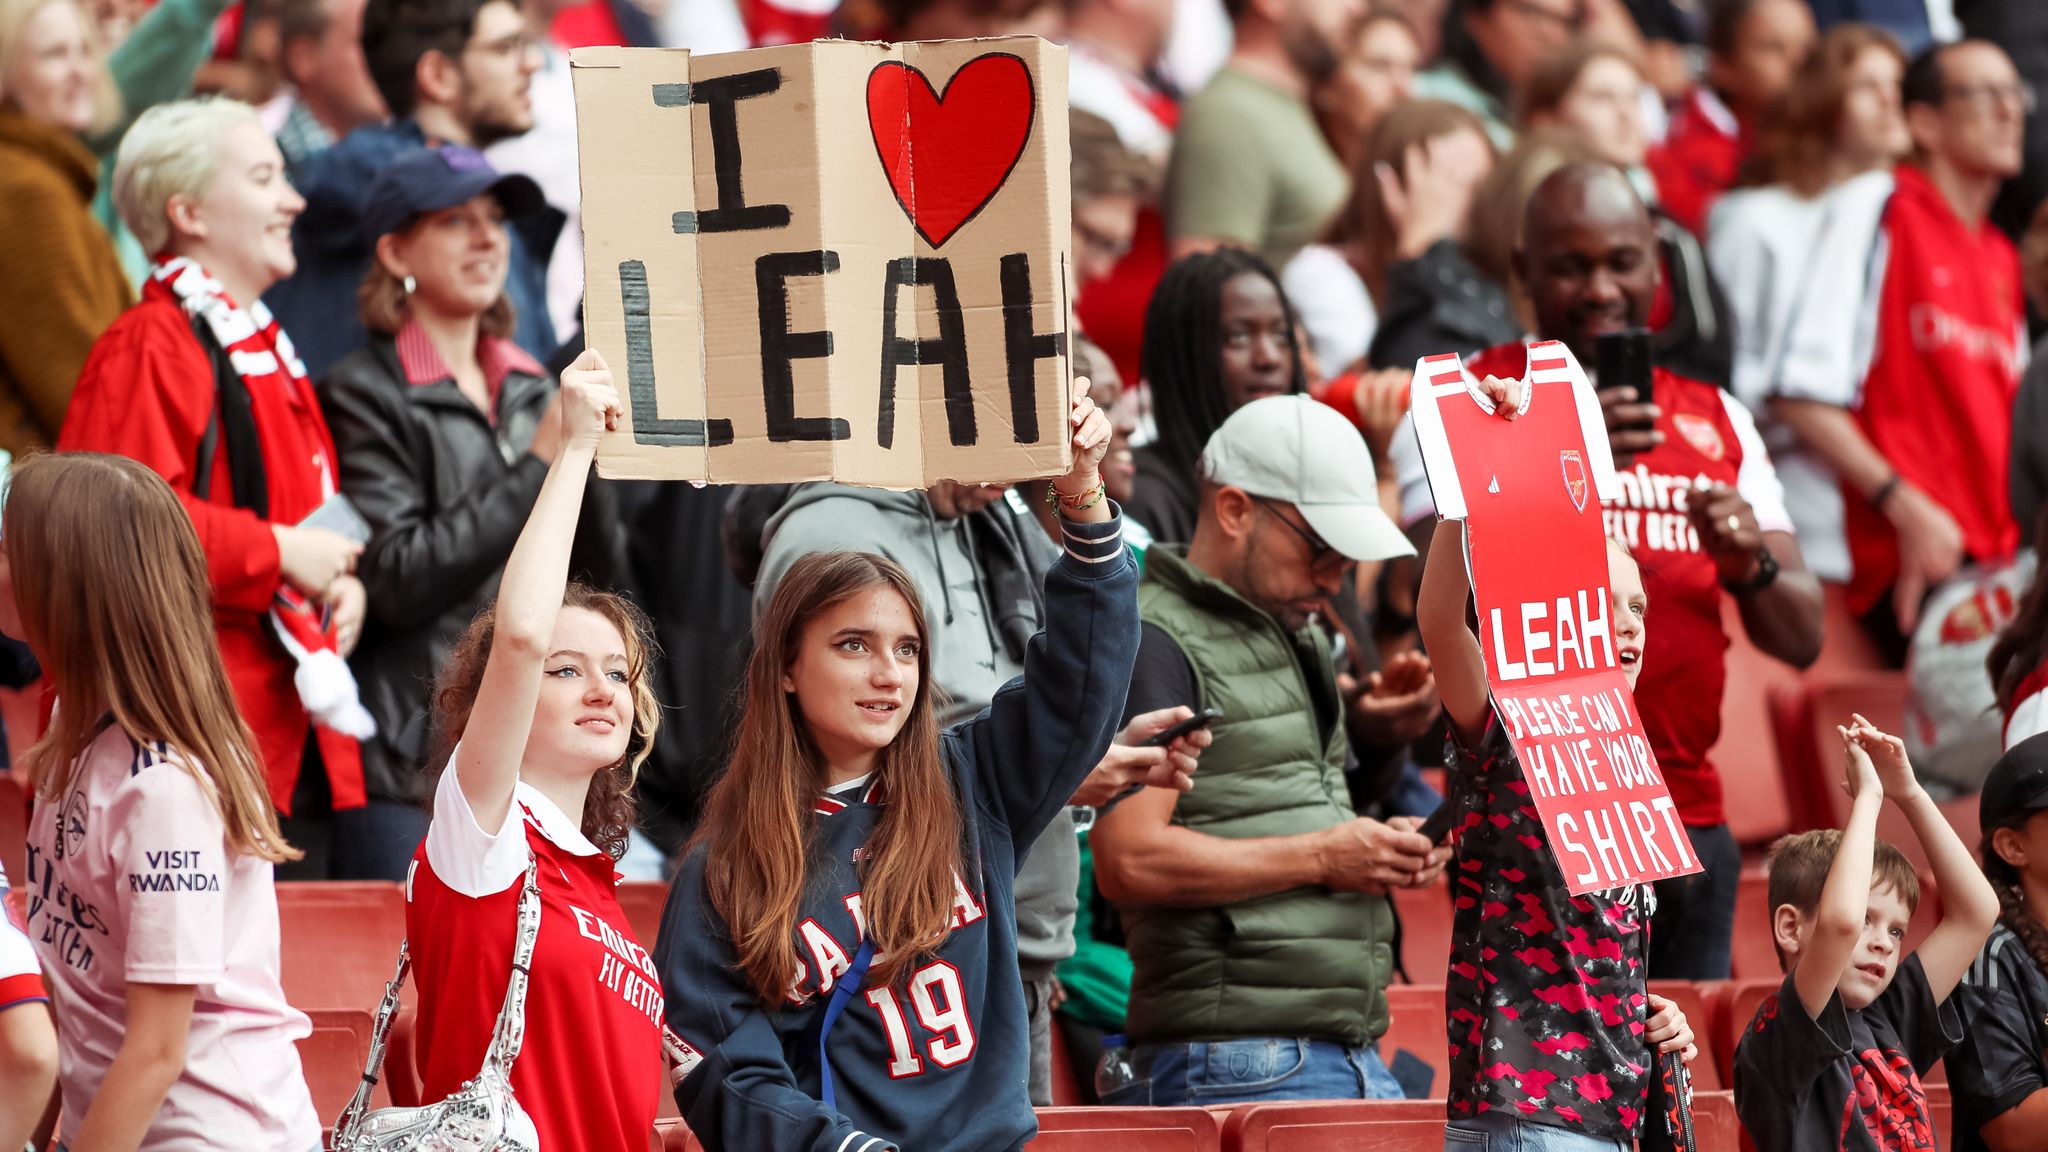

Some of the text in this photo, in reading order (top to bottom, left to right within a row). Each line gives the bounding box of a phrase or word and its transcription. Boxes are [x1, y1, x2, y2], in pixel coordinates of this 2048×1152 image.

[652, 66, 791, 234] I
[619, 250, 1070, 449] LEAH
[1491, 587, 1616, 680] LEAH
[1501, 687, 1632, 739] PLEASE CAN I
[1525, 733, 1661, 798] HAVE YOUR
[146, 851, 200, 869] VISIT
[1556, 796, 1692, 885] SHIRT
[129, 873, 220, 892] RWANDA
[568, 904, 660, 986] Emira
[598, 951, 665, 1029] FLY BETTER
[865, 959, 977, 1079] 19
